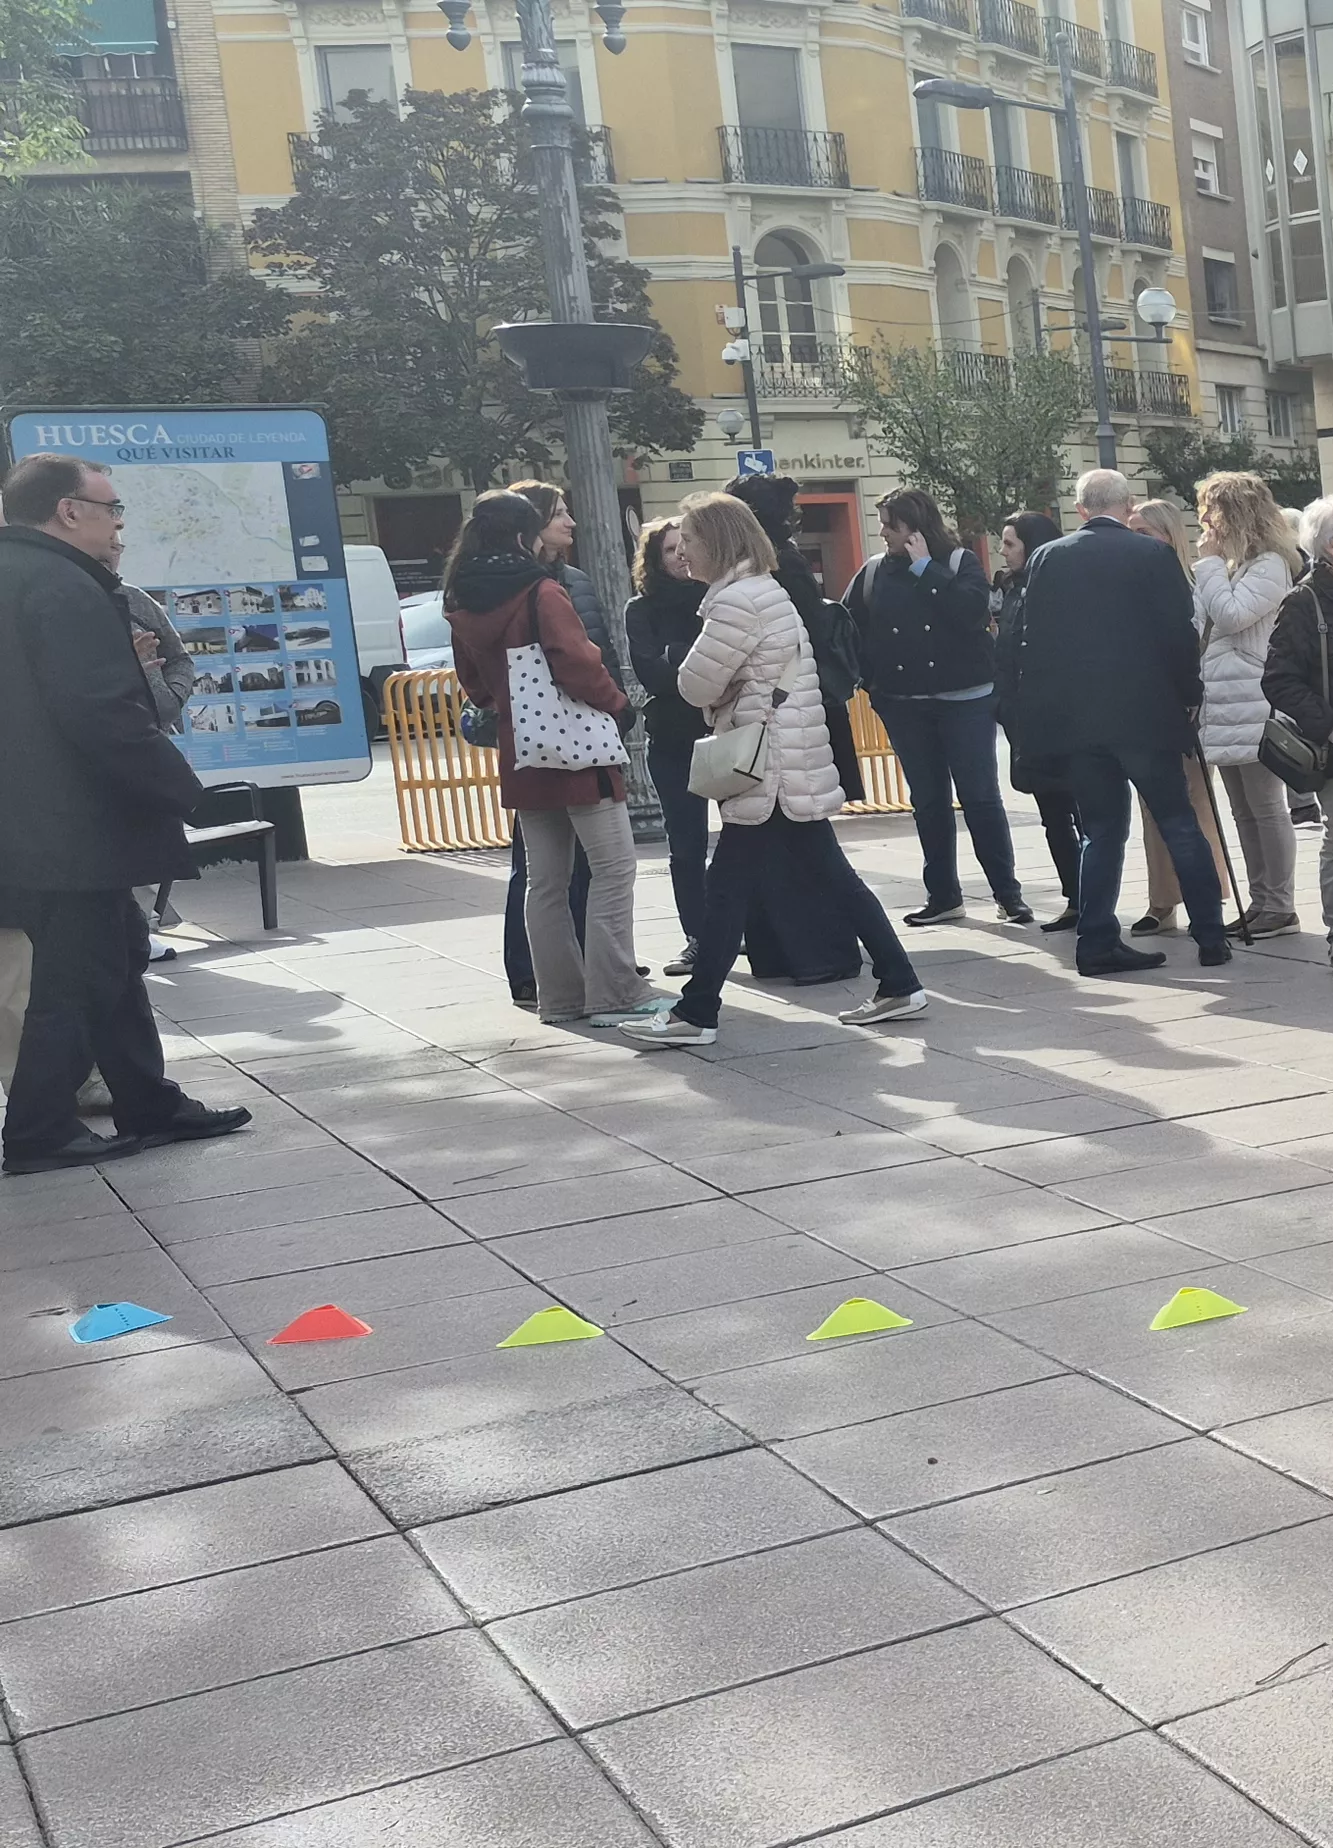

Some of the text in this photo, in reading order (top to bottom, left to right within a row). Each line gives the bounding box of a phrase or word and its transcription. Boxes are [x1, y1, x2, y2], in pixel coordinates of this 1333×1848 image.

[35, 424, 307, 447] HUESCA CIUDAD DE LEYENDA
[116, 444, 235, 461] QUÉ VISITAR
[775, 453, 865, 470] ankinter.
